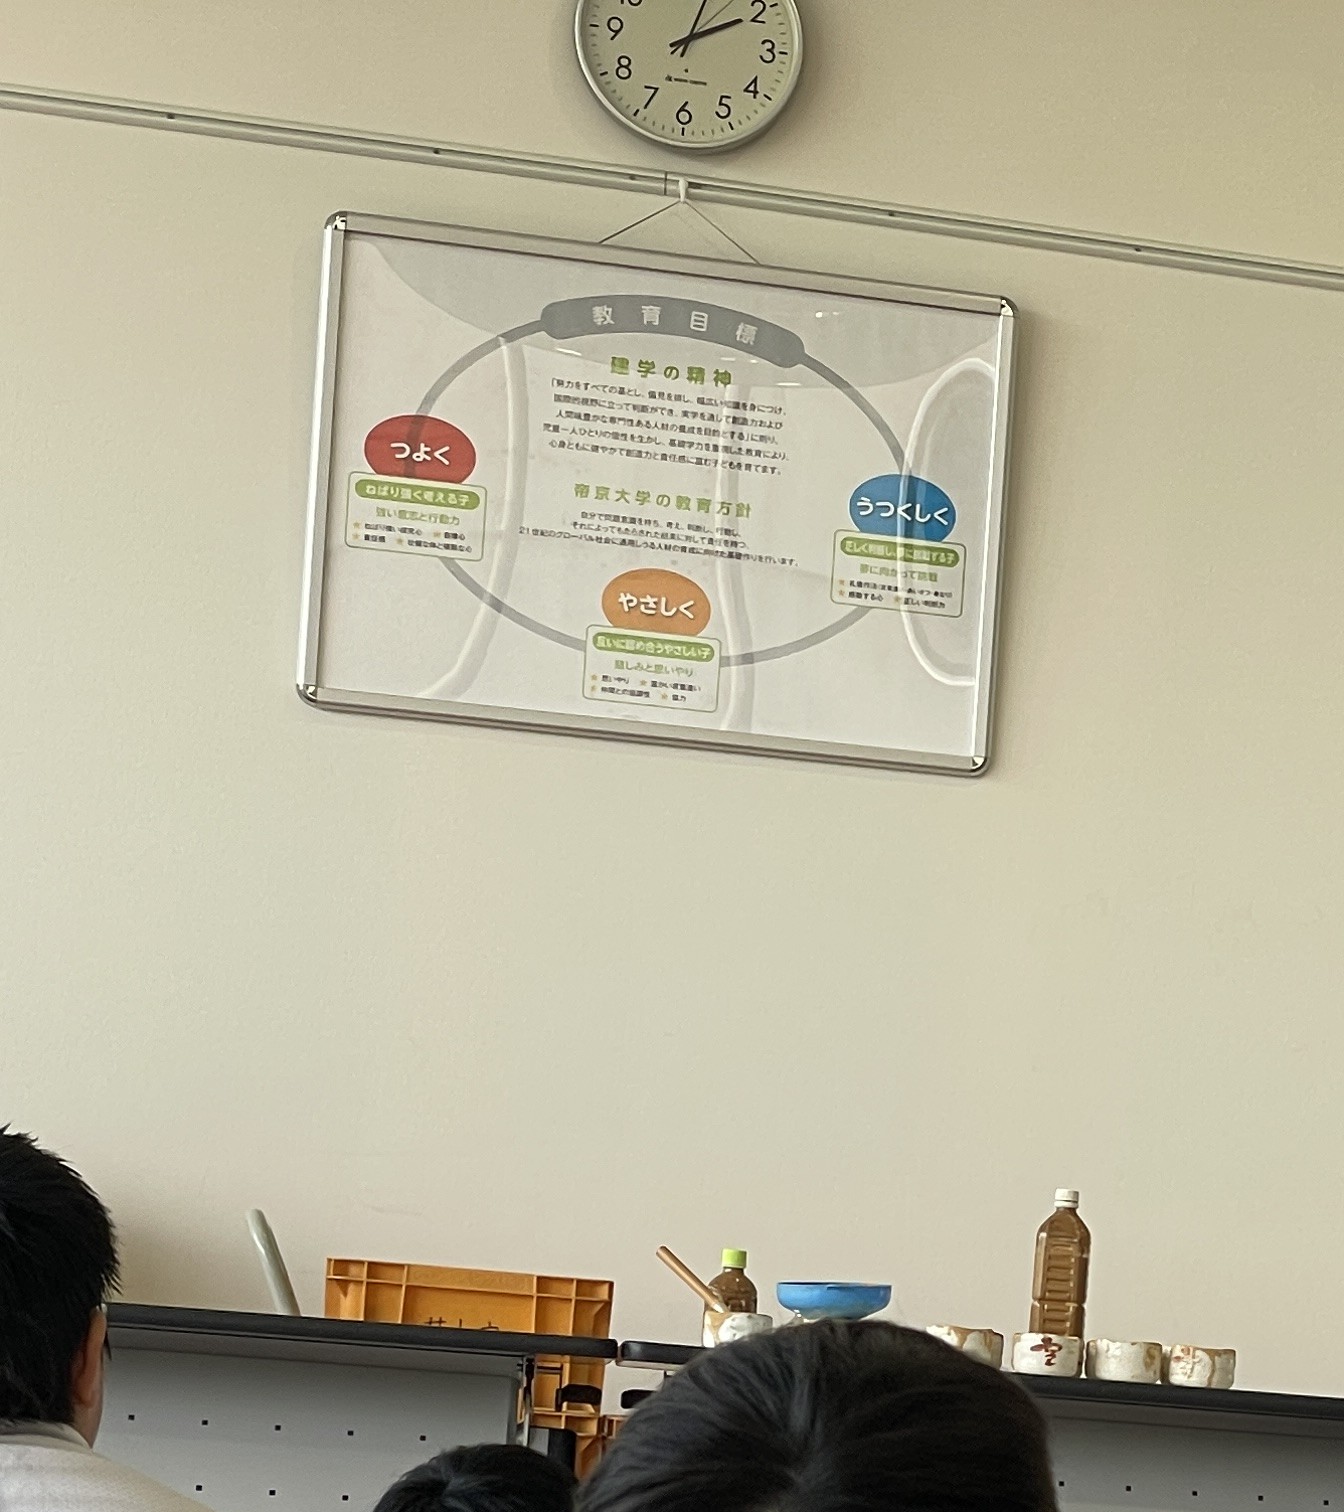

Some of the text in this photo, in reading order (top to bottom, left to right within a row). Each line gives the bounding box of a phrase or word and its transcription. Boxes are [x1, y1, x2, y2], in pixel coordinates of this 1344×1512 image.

[750, 0, 767, 24] 2
[606, 16, 624, 41] 9
[759, 38, 776, 64] 3
[615, 55, 632, 80] 8
[643, 85, 660, 109] 7
[743, 75, 760, 99] 4
[675, 100, 693, 125] 6
[714, 95, 732, 119] 5
[592, 304, 758, 346] 教育目標
[390, 442, 450, 466] つよく
[574, 482, 752, 519] 帝京大学の教育方針
[856, 496, 949, 526] うつくしく
[618, 592, 695, 619] やさしく
